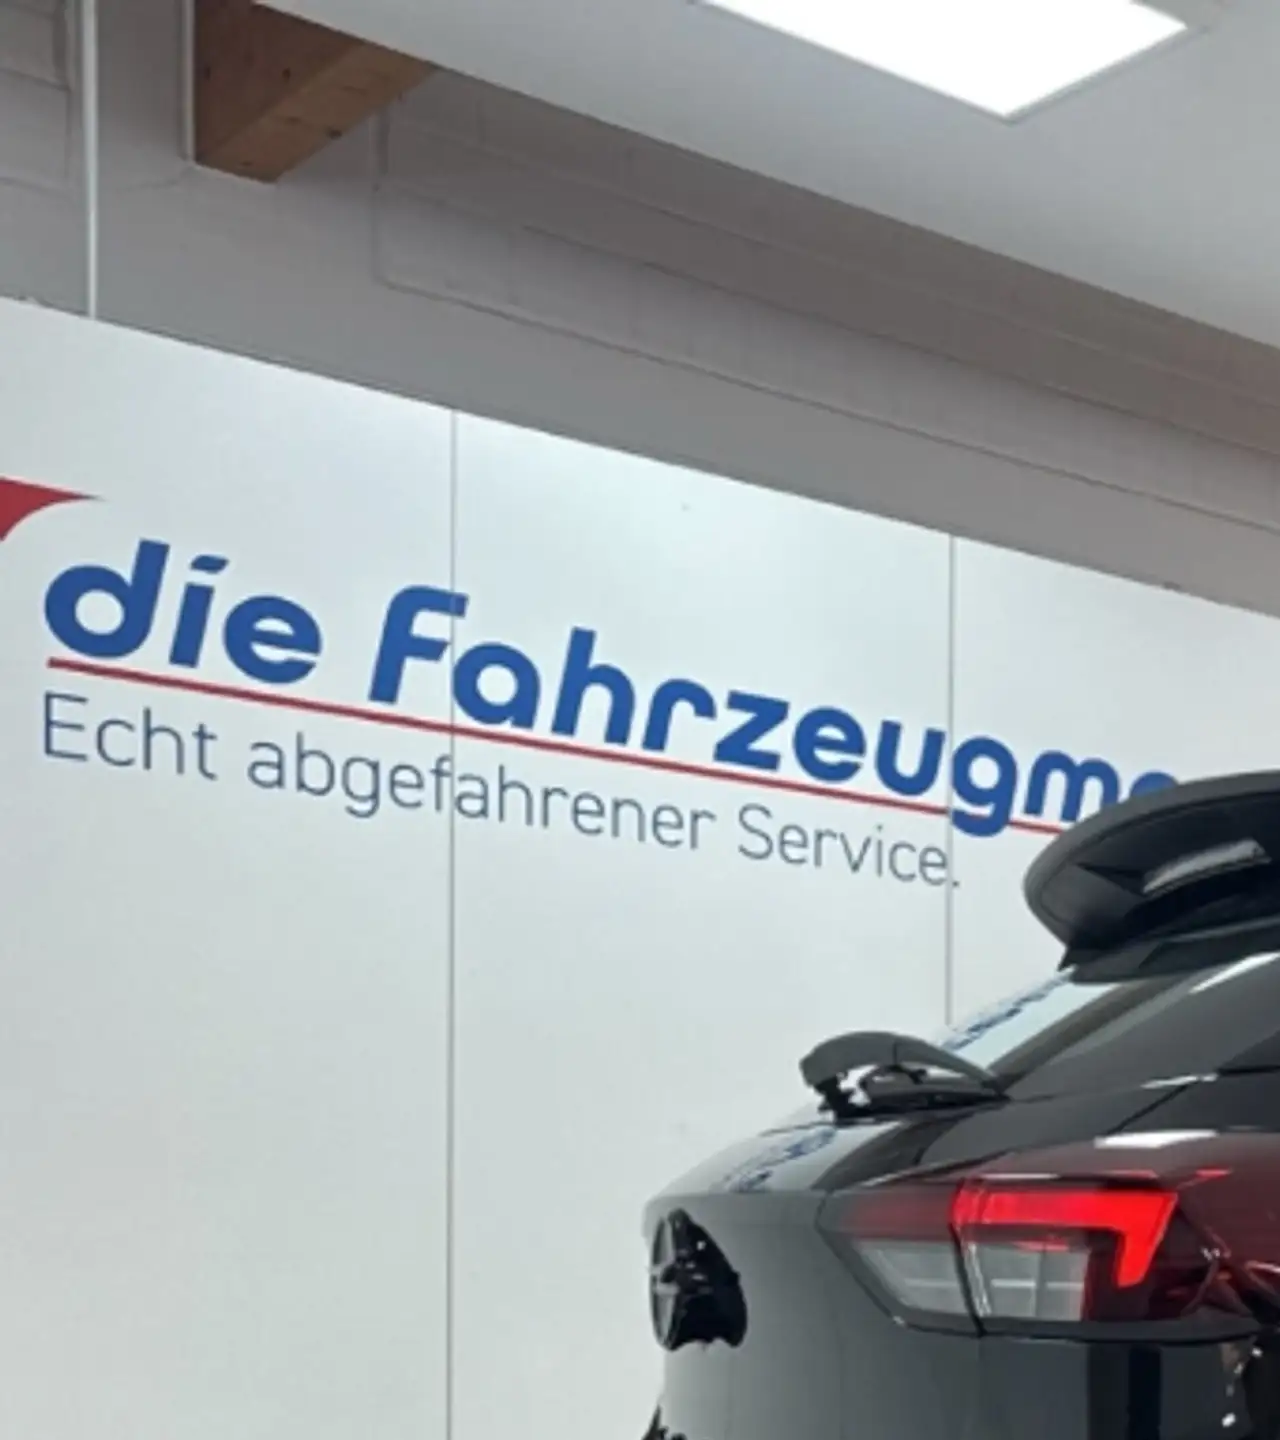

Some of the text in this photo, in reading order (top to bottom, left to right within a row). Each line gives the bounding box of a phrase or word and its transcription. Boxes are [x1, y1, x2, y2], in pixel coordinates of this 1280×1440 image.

[43, 691, 960, 888] Echt abgefahrener Service.
[44, 539, 1178, 837] die Fahrzeugm
